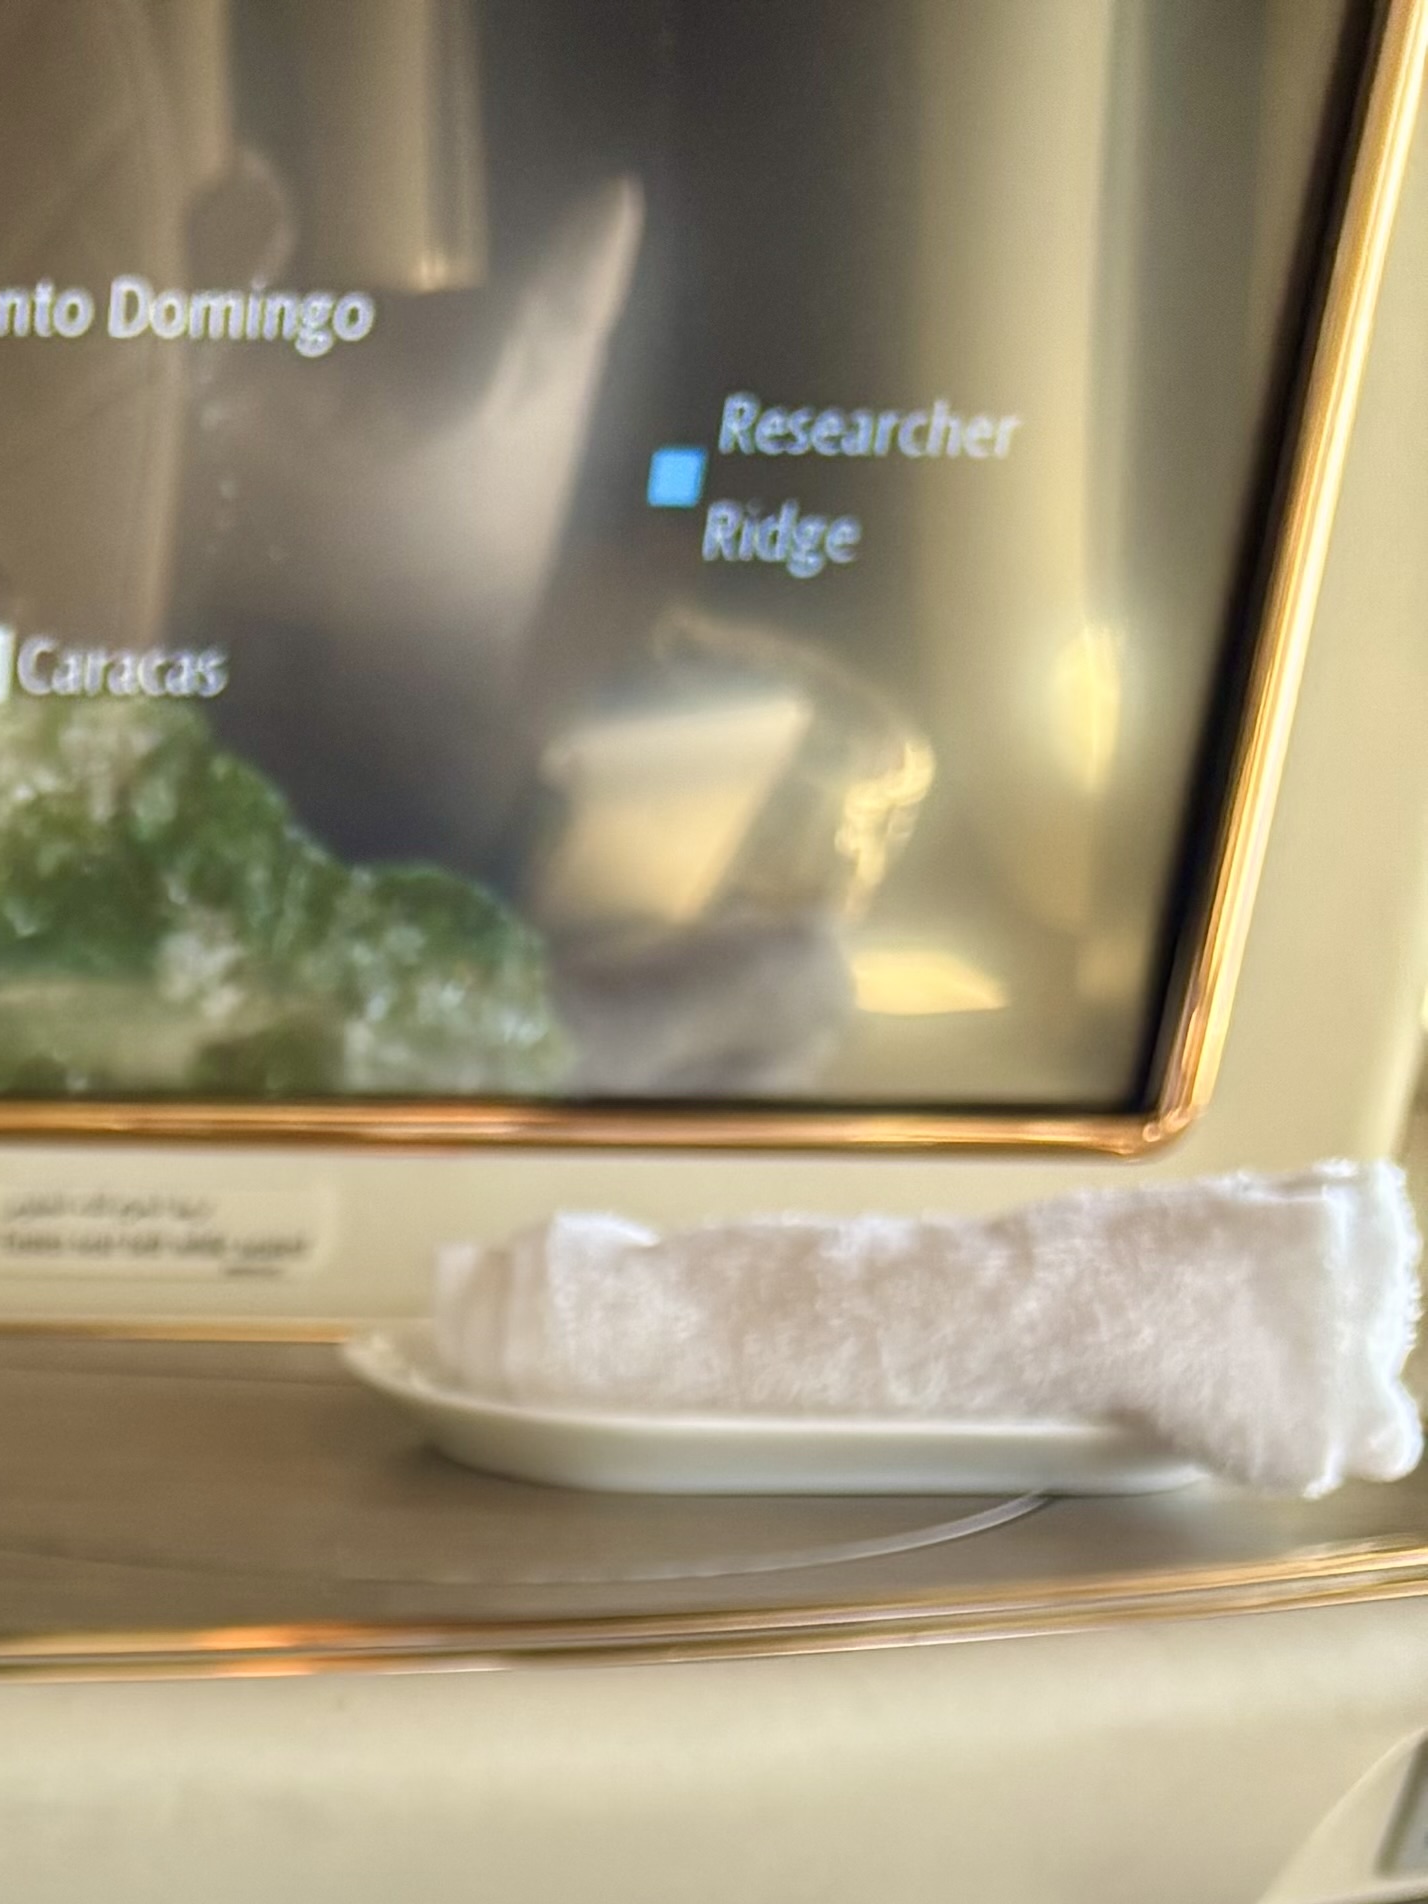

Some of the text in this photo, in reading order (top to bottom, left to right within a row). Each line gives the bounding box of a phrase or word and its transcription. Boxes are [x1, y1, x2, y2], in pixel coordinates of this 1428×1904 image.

[107, 273, 376, 359] Domingo
[717, 390, 1023, 460] Researcher
[701, 499, 863, 579] Ridge
[17, 635, 228, 699] Caracas
